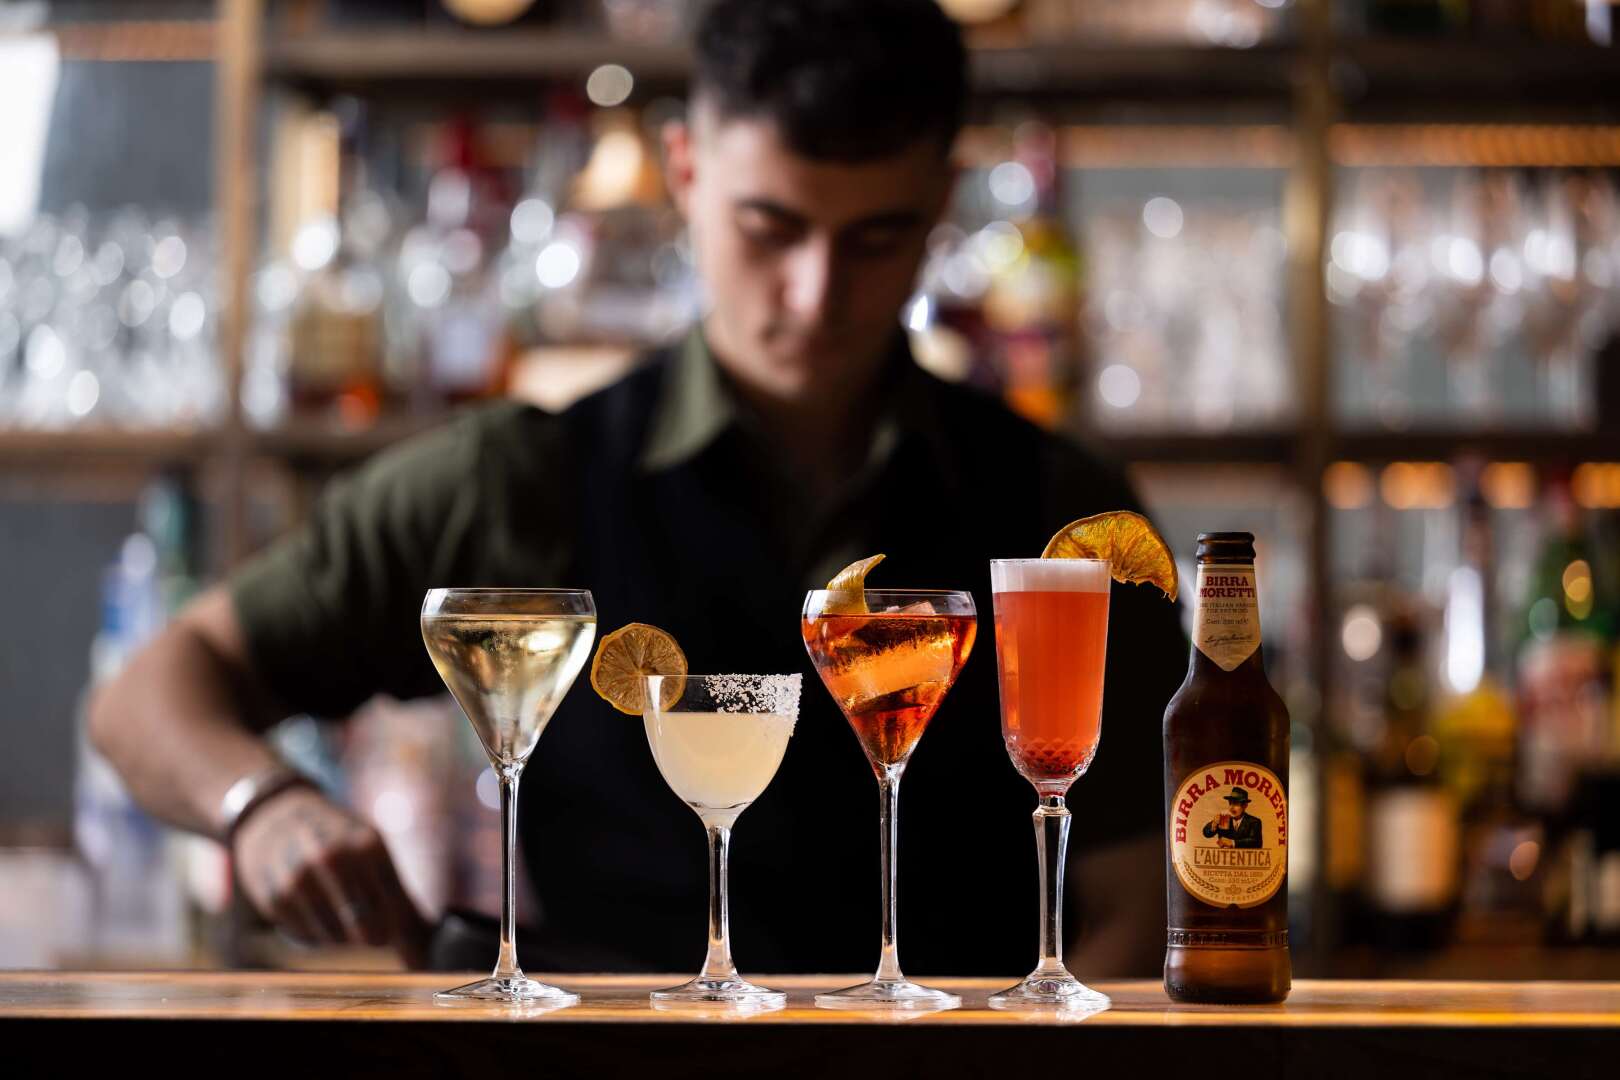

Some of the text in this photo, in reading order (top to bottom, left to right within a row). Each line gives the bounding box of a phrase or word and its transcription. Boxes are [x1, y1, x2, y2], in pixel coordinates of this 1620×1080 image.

[1205, 576, 1249, 586] BIRRA
[1199, 587, 1255, 598] MORETTI
[1175, 768, 1288, 847] BIRRA MORETTI
[1193, 848, 1272, 867] L'AUTENTICA
